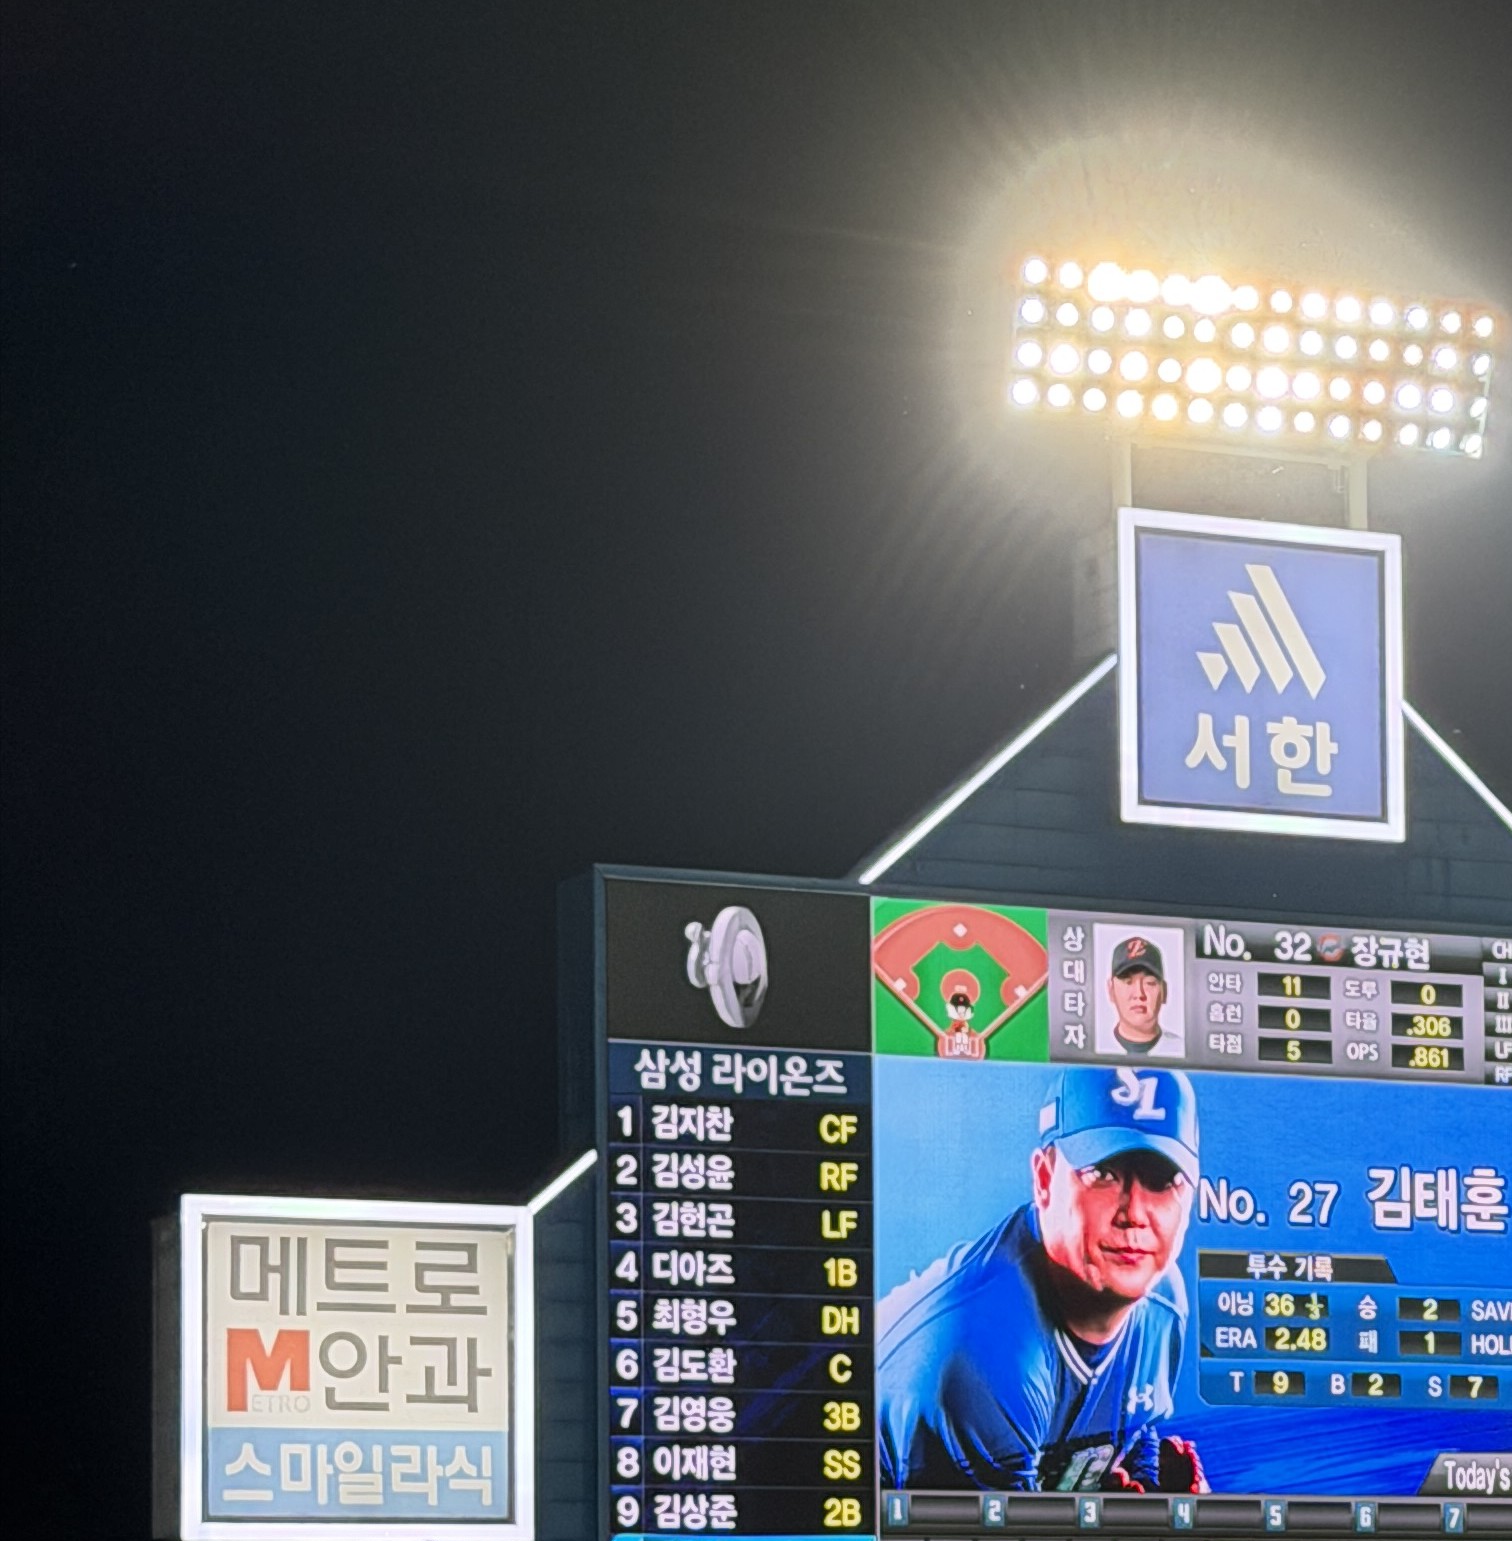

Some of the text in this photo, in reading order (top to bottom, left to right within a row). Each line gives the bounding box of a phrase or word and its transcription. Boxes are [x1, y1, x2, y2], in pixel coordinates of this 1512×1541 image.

[1184, 712, 1339, 797] 서한
[1203, 923, 1431, 971] No. 32 장규현
[1208, 972, 1302, 997] 안타 11
[1345, 978, 1436, 1005] 도루 0
[1285, 1010, 1301, 1031] 0
[1406, 1015, 1452, 1038] .306
[1208, 1033, 1301, 1062] 타점 5
[1346, 1041, 1450, 1069] OPS .861
[634, 1049, 847, 1097] 삼성 라이온즈
[651, 1103, 858, 1144] 김지찬 CF
[651, 1152, 859, 1192] 김성윤 RF
[1200, 1166, 1510, 1232] No. 27 김태훈
[821, 1210, 858, 1239] LF
[230, 1234, 488, 1317] 메트로
[652, 1249, 858, 1287] 디아즈 1B
[1247, 1255, 1334, 1282] 투수 기록
[652, 1298, 859, 1336] 최형우 DH
[1218, 1291, 1295, 1317] 이닝 36
[1359, 1296, 1438, 1320] 승 2
[1215, 1327, 1327, 1352] ERA 2.48
[1424, 1332, 1435, 1354] 1
[318, 1331, 492, 1413] 안과
[652, 1347, 853, 1384] 김도환 C
[1229, 1371, 1243, 1393] T
[1273, 1371, 1290, 1394] 9
[1330, 1374, 1346, 1395] B
[1368, 1375, 1384, 1397] 2
[1428, 1376, 1443, 1397] S
[1468, 1377, 1483, 1398] 7
[653, 1396, 861, 1433] 김영웅 3B
[222, 1440, 493, 1506] 스마일라식
[652, 1444, 861, 1481] 이재현 SS
[1444, 1459, 1511, 1495] Today's
[653, 1494, 862, 1531] 김상준 2B
